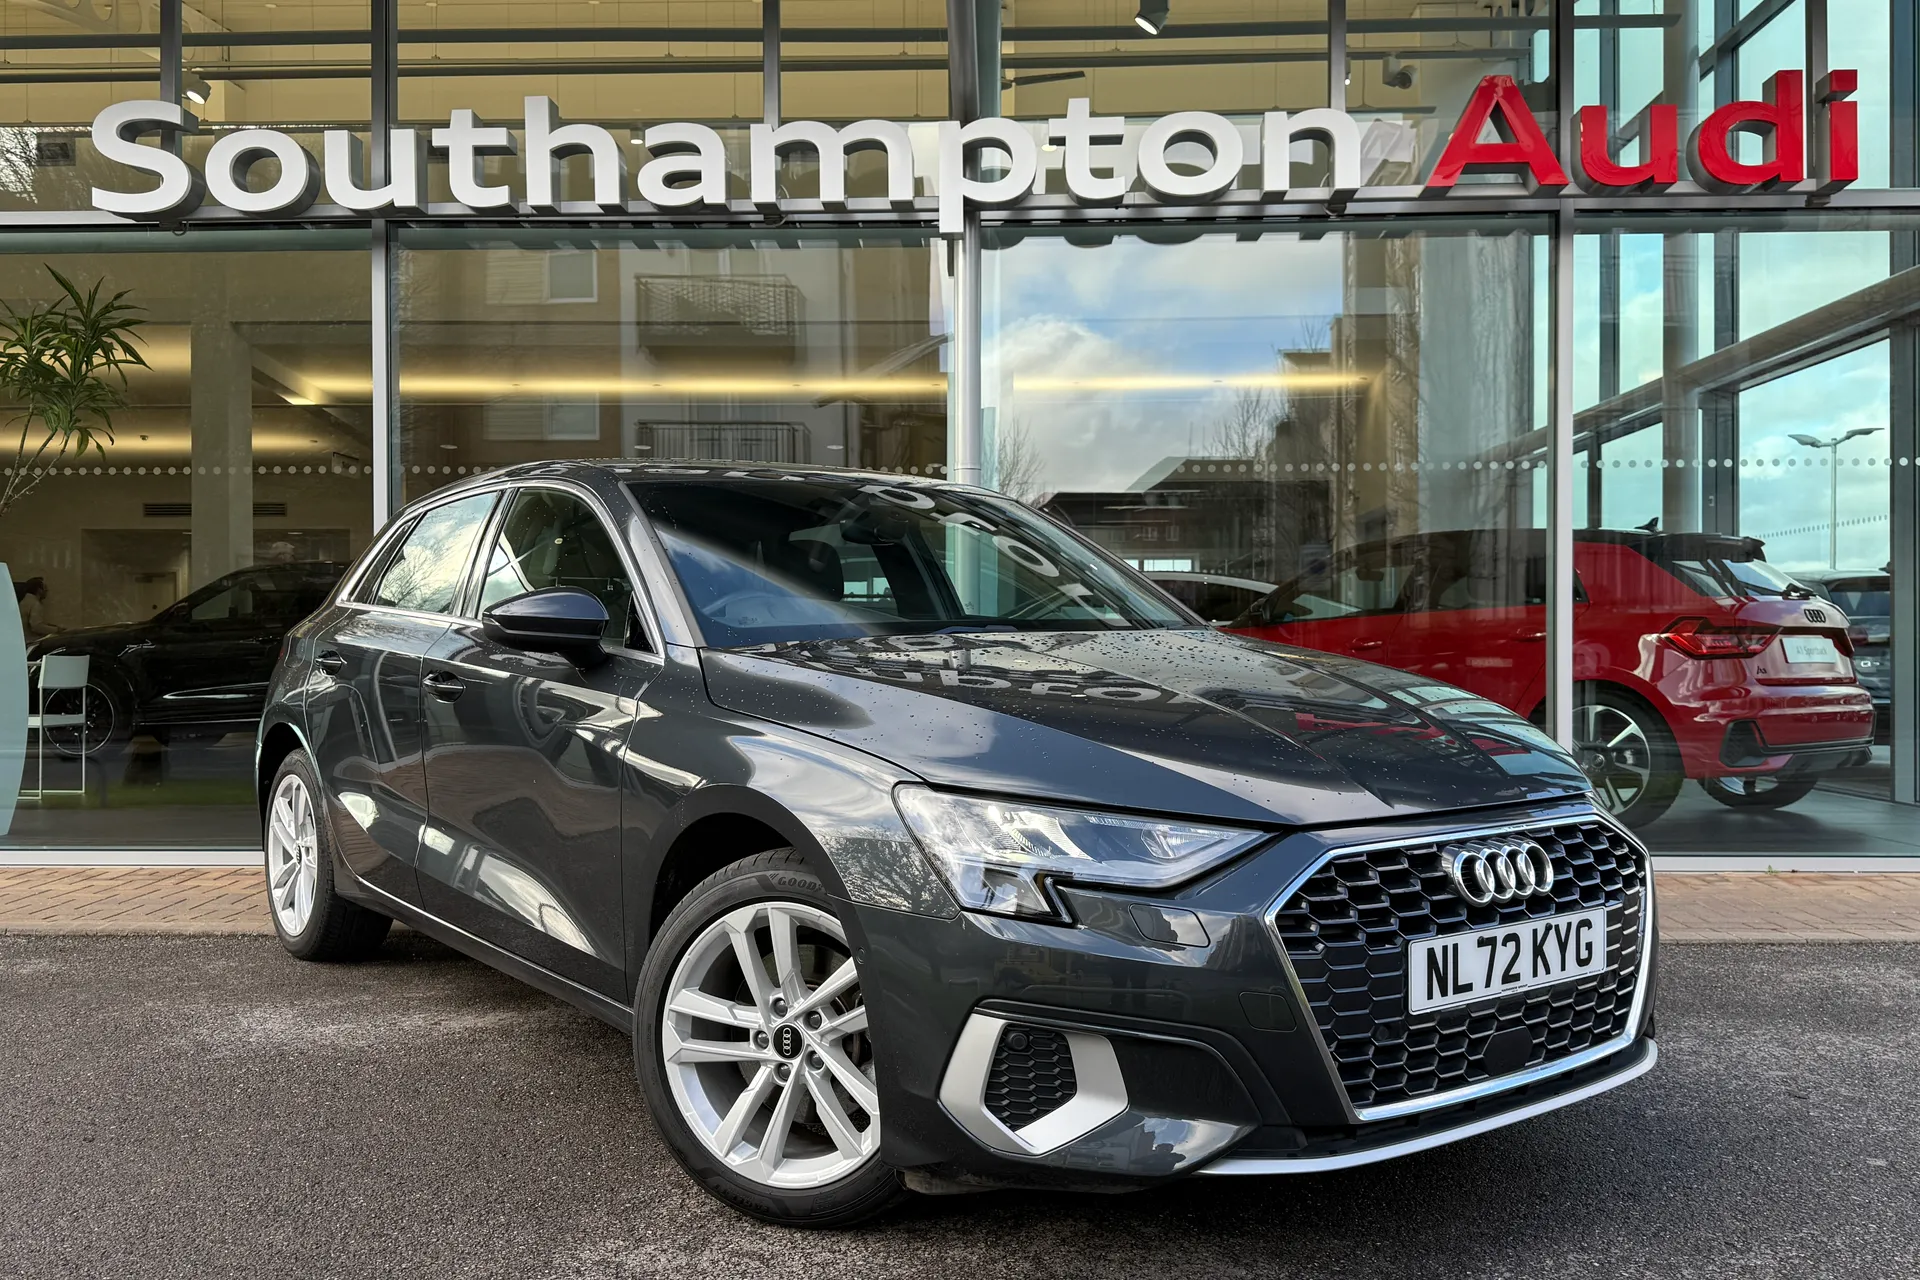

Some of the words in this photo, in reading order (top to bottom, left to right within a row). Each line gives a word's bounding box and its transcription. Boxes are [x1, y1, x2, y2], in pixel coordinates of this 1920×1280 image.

[91, 95, 1362, 238] Southampton
[1423, 69, 1859, 193] Audi
[1426, 932, 1521, 1001] NL72
[1532, 918, 1594, 979] KYG
